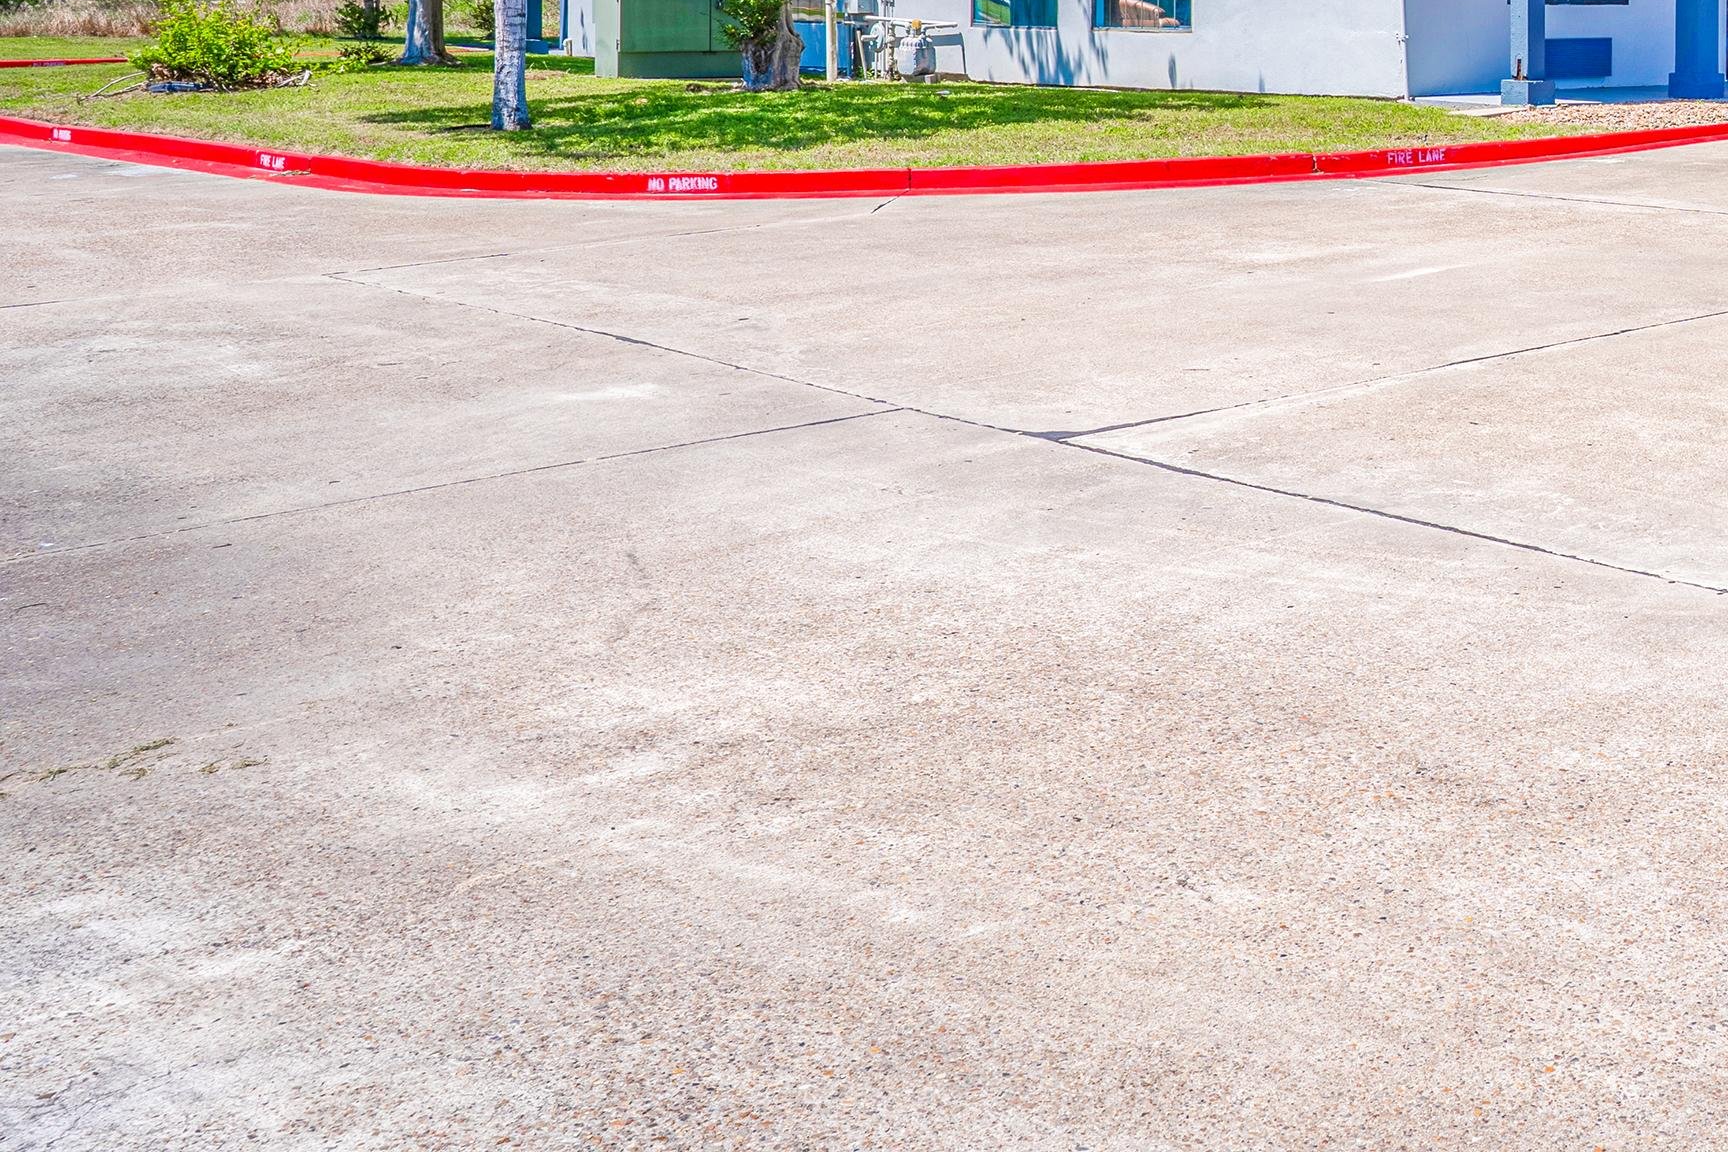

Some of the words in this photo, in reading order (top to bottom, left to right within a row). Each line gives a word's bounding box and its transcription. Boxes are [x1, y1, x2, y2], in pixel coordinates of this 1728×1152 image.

[1387, 150, 1413, 165] FIRE
[1418, 148, 1446, 163] LANE
[648, 177, 665, 191] NO
[668, 177, 718, 191] PARKING
